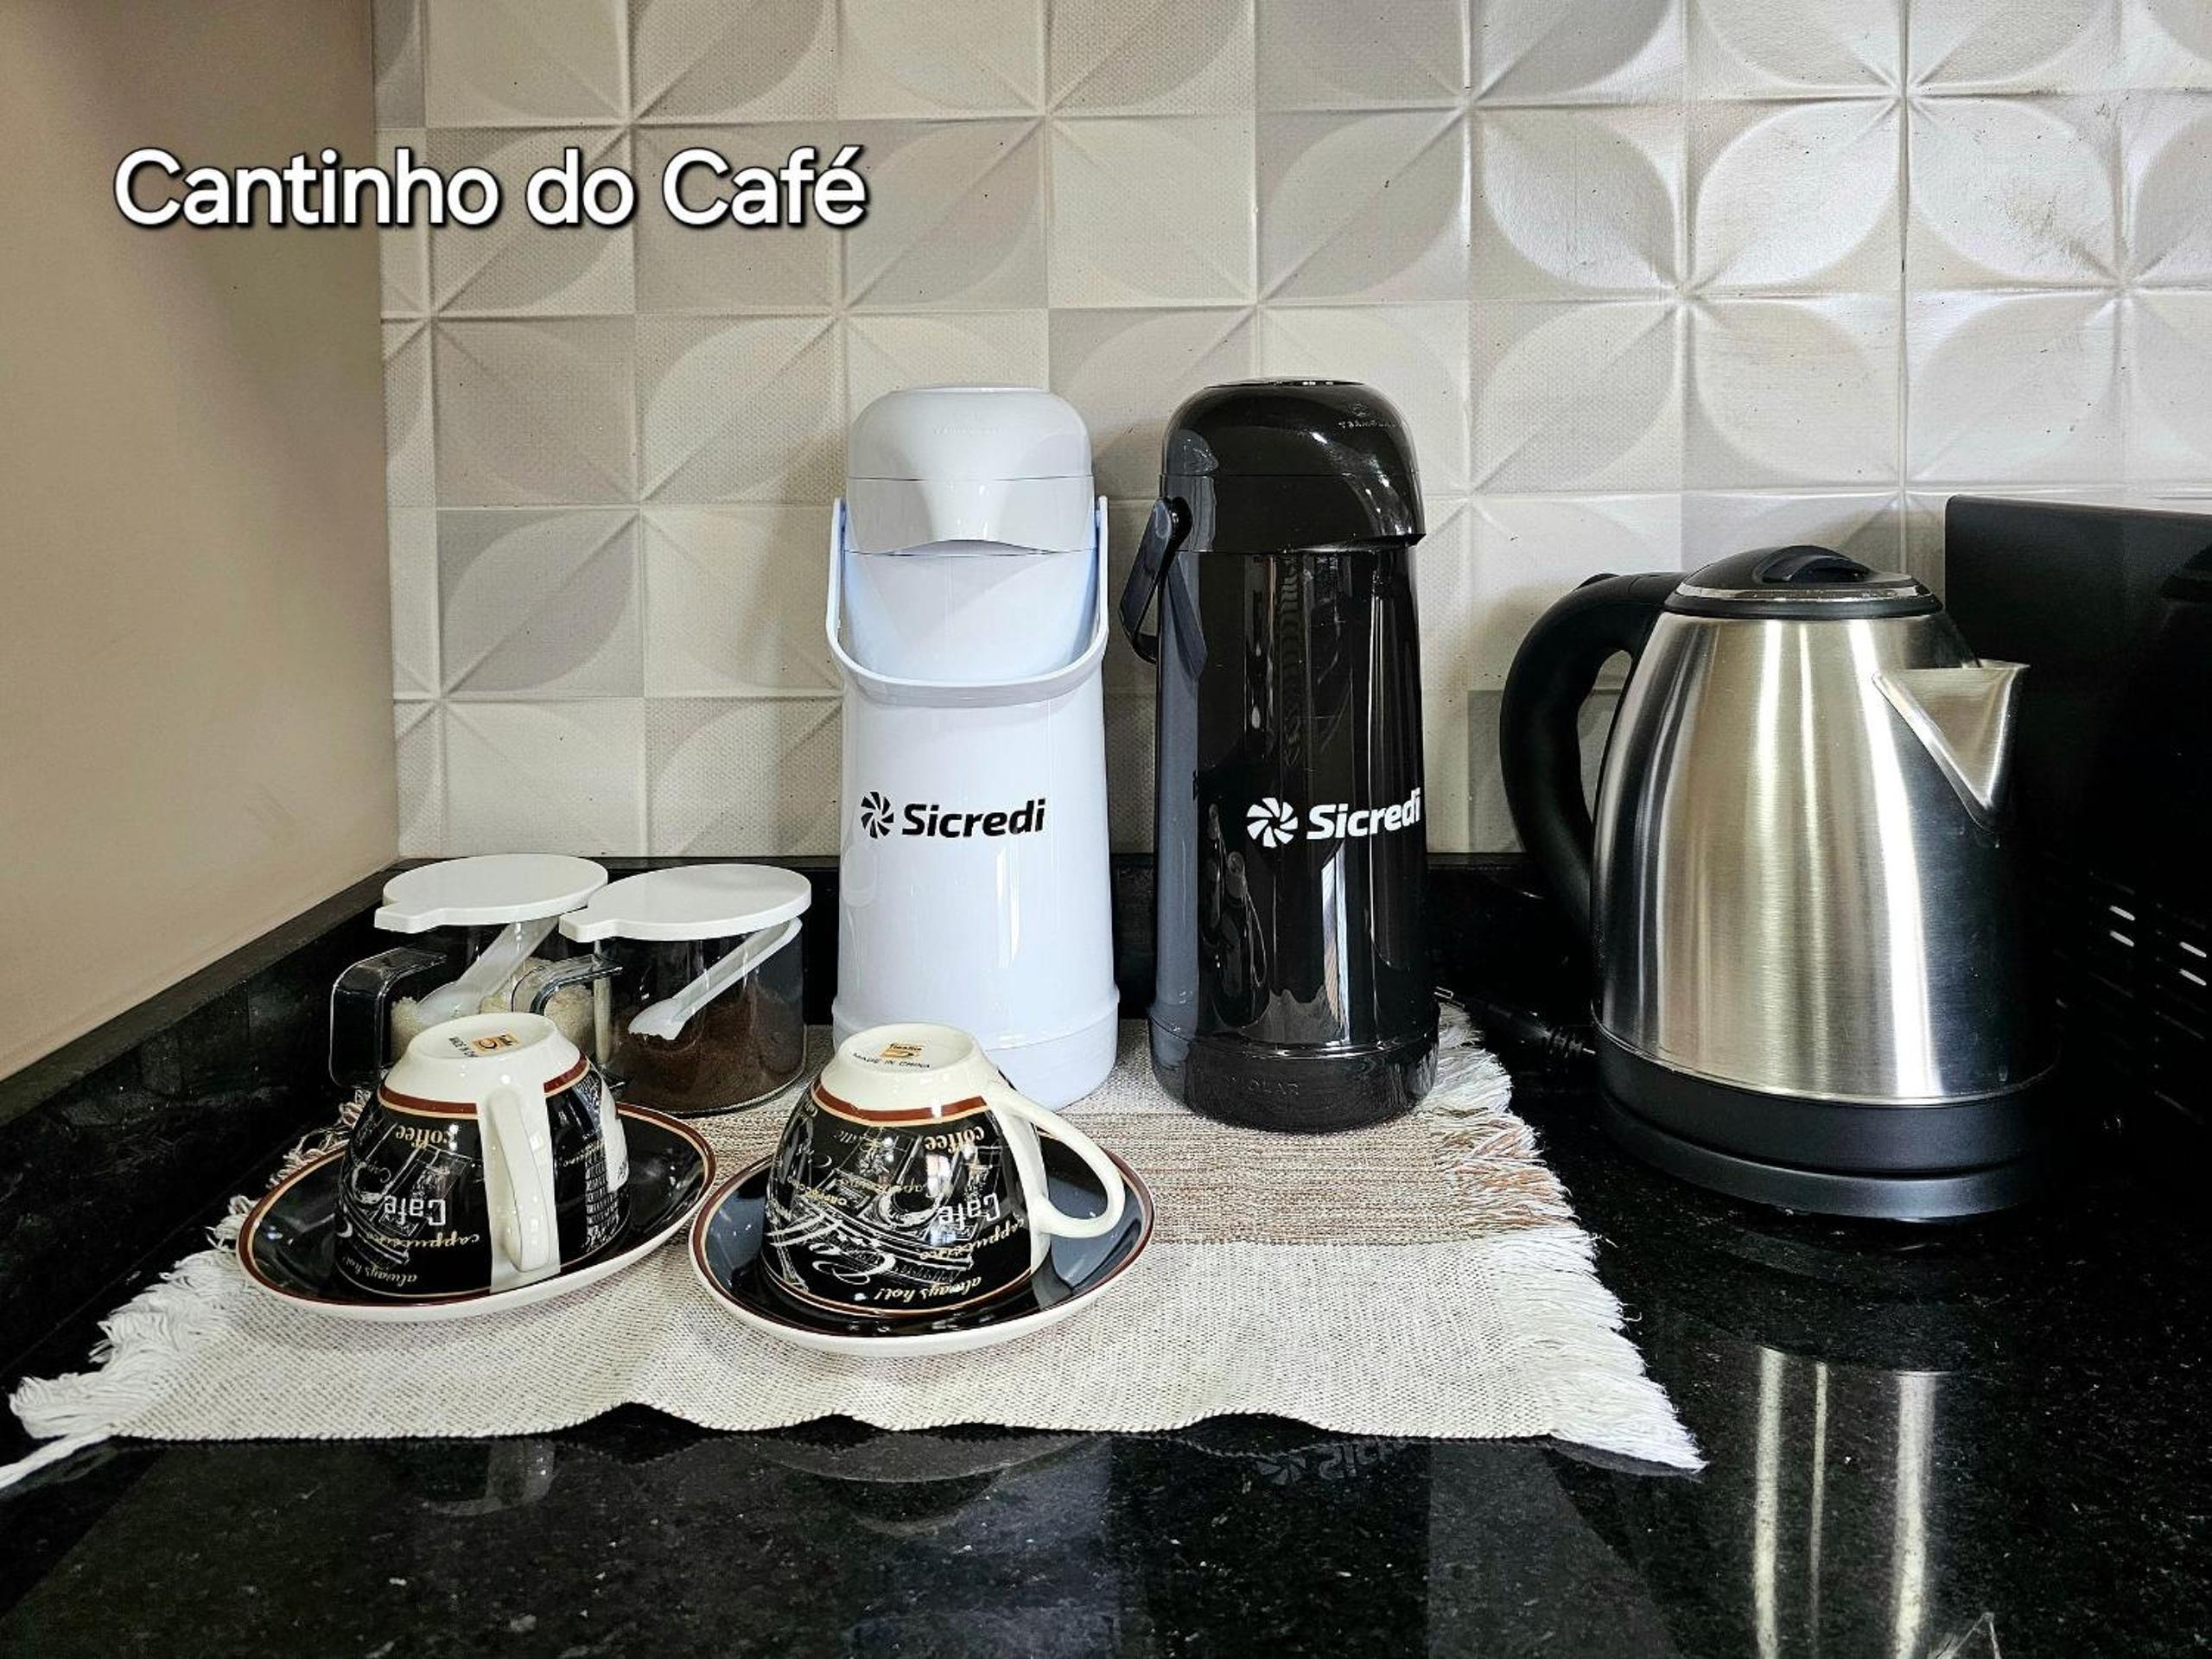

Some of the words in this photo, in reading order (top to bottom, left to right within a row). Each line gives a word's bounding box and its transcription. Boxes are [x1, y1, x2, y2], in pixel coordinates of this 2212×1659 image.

[901, 798, 1046, 838] Sicredi
[1306, 787, 1421, 840] Sicredi
[395, 1125, 455, 1150] coffee
[923, 1126, 985, 1155] coffee
[364, 1264, 418, 1287] always
[874, 1287, 916, 1304] hot!
[919, 1276, 982, 1301] always
